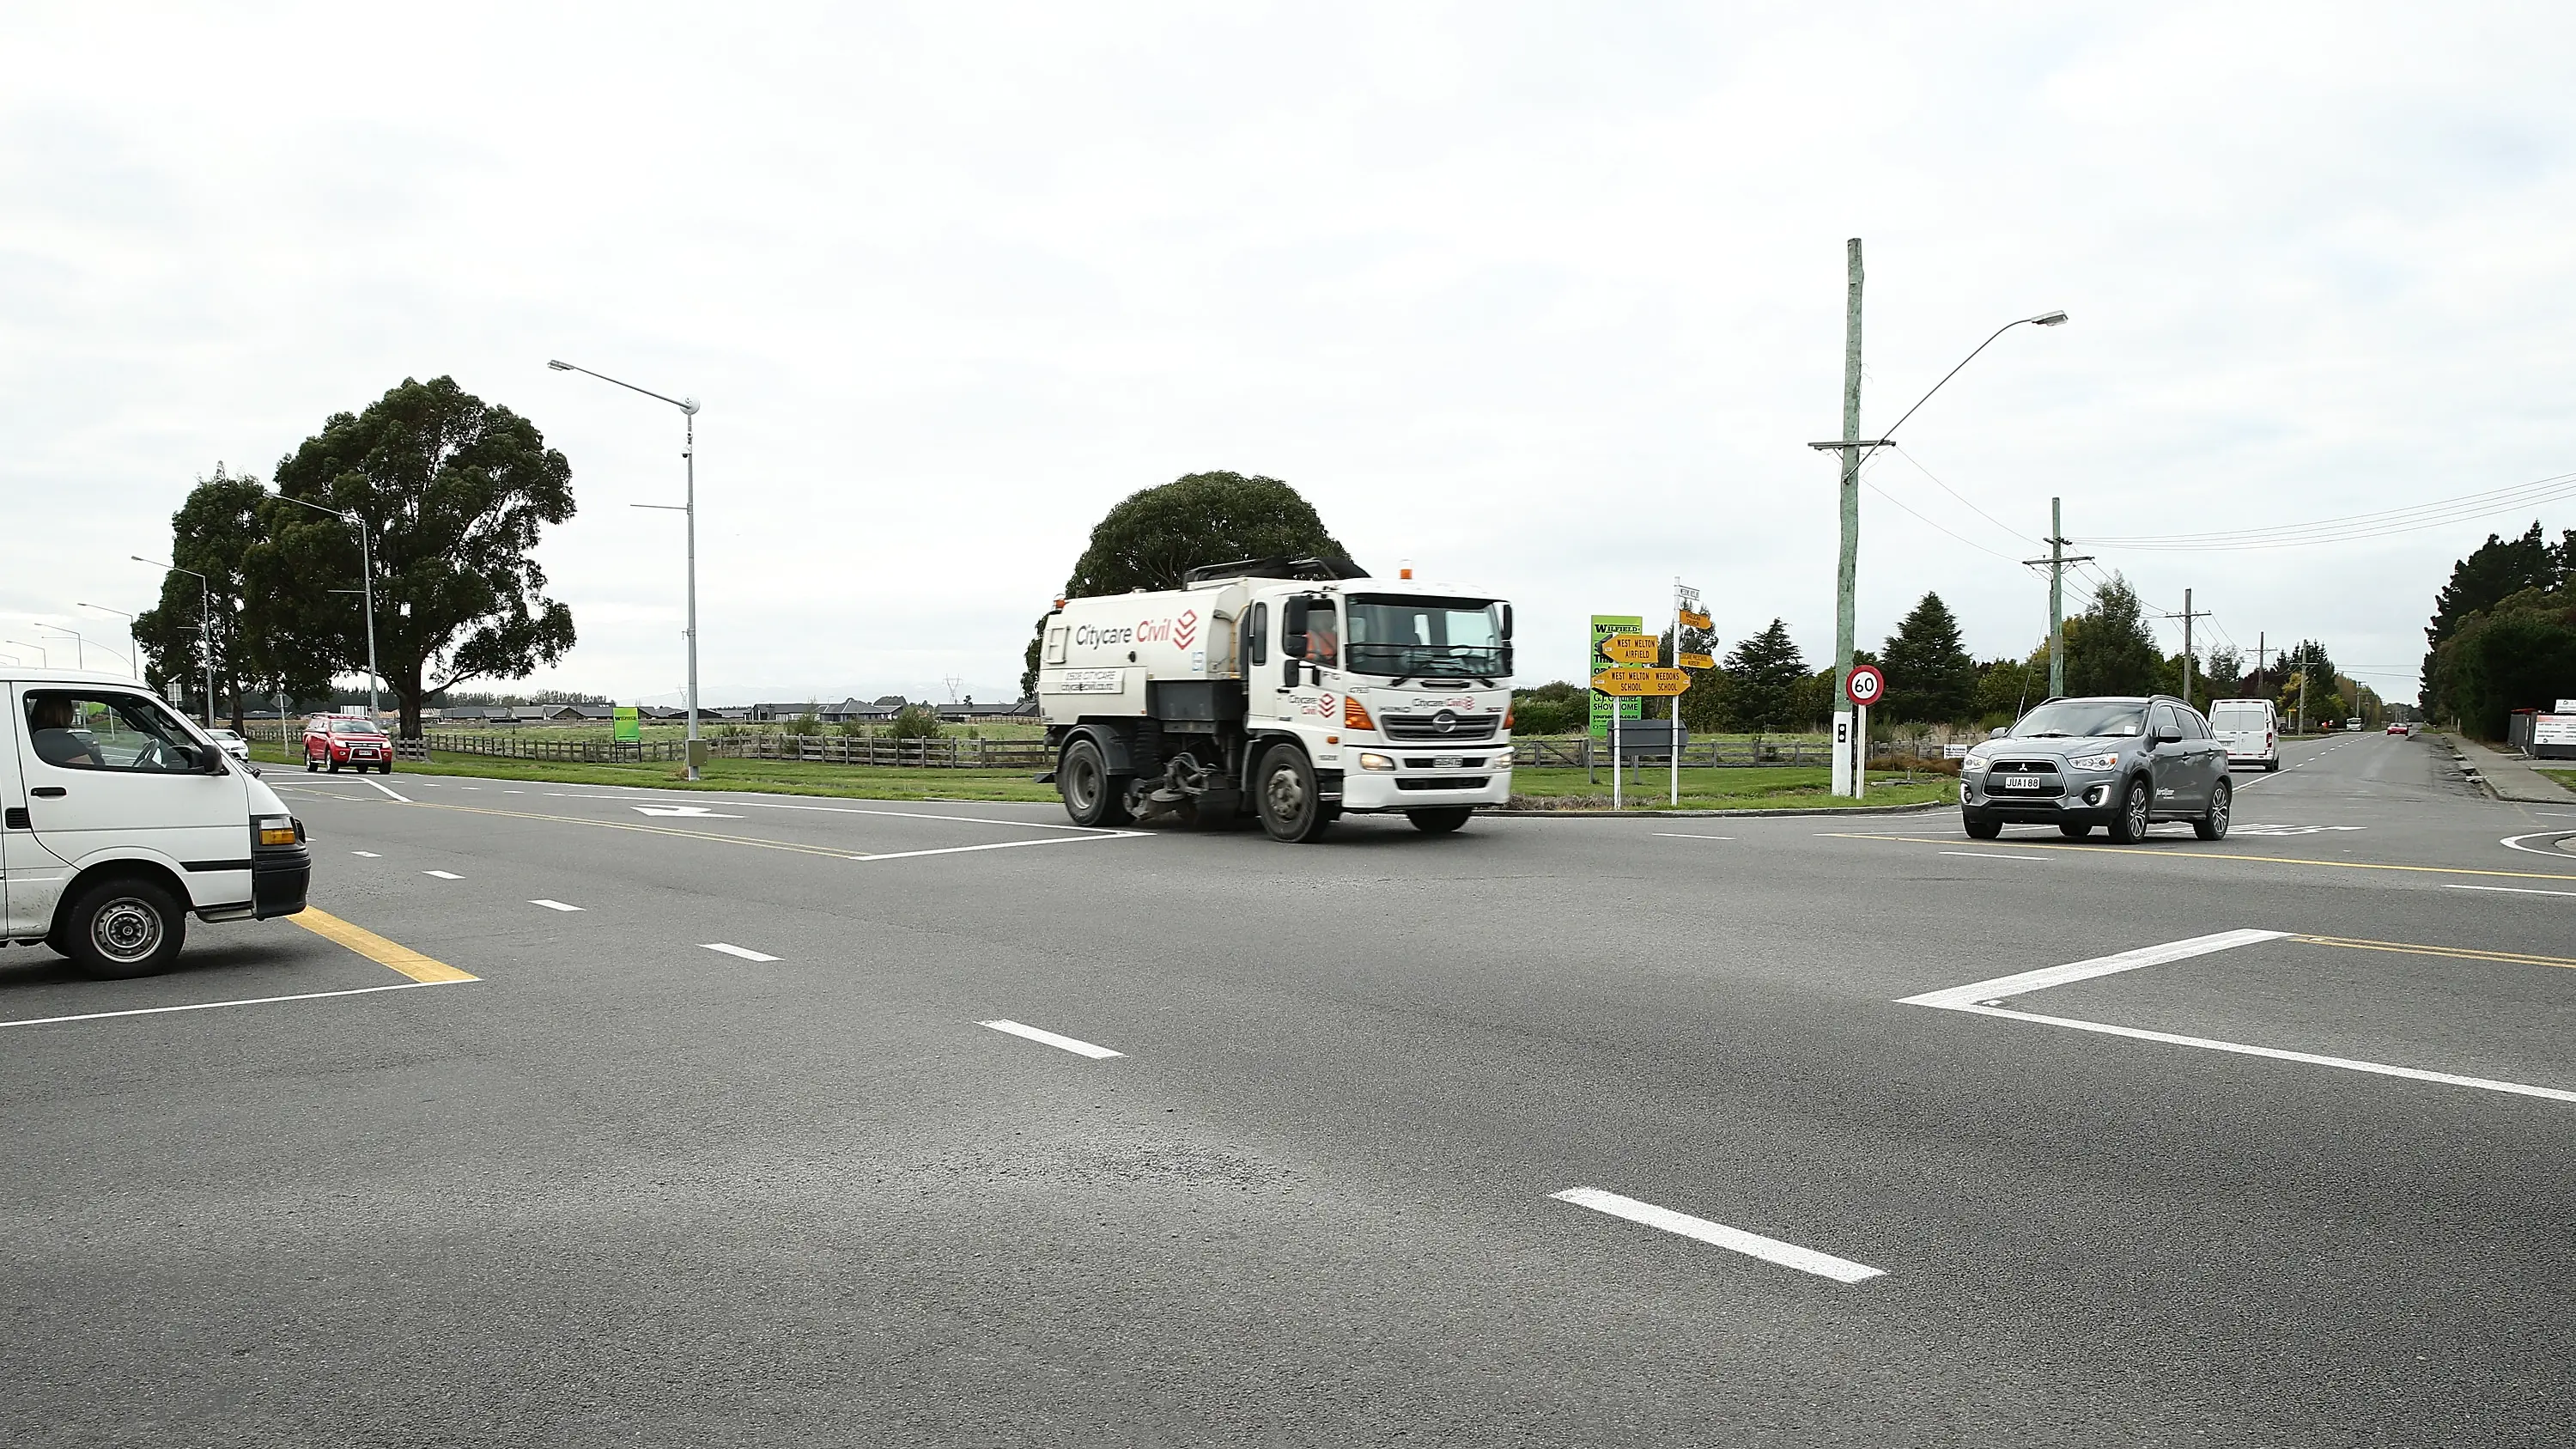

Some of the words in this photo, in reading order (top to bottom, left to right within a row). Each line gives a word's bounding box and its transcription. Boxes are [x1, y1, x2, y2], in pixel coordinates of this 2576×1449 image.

[1076, 624, 1133, 650] Citycare
[1136, 618, 1172, 642] Civil
[1617, 638, 1631, 648] WEST
[1634, 639, 1656, 648] MELTON
[1625, 650, 1649, 659] AIRFIELD
[1612, 672, 1625, 680] WEST
[1628, 672, 1649, 680] MELTON
[1656, 672, 1680, 680] WEEDONS
[1620, 683, 1643, 691] SCHOOL
[1657, 683, 1678, 691] SCHOOL
[1855, 678, 1874, 693] 60
[1412, 697, 1446, 709] Citycare
[2006, 778, 2038, 788] JUA188
